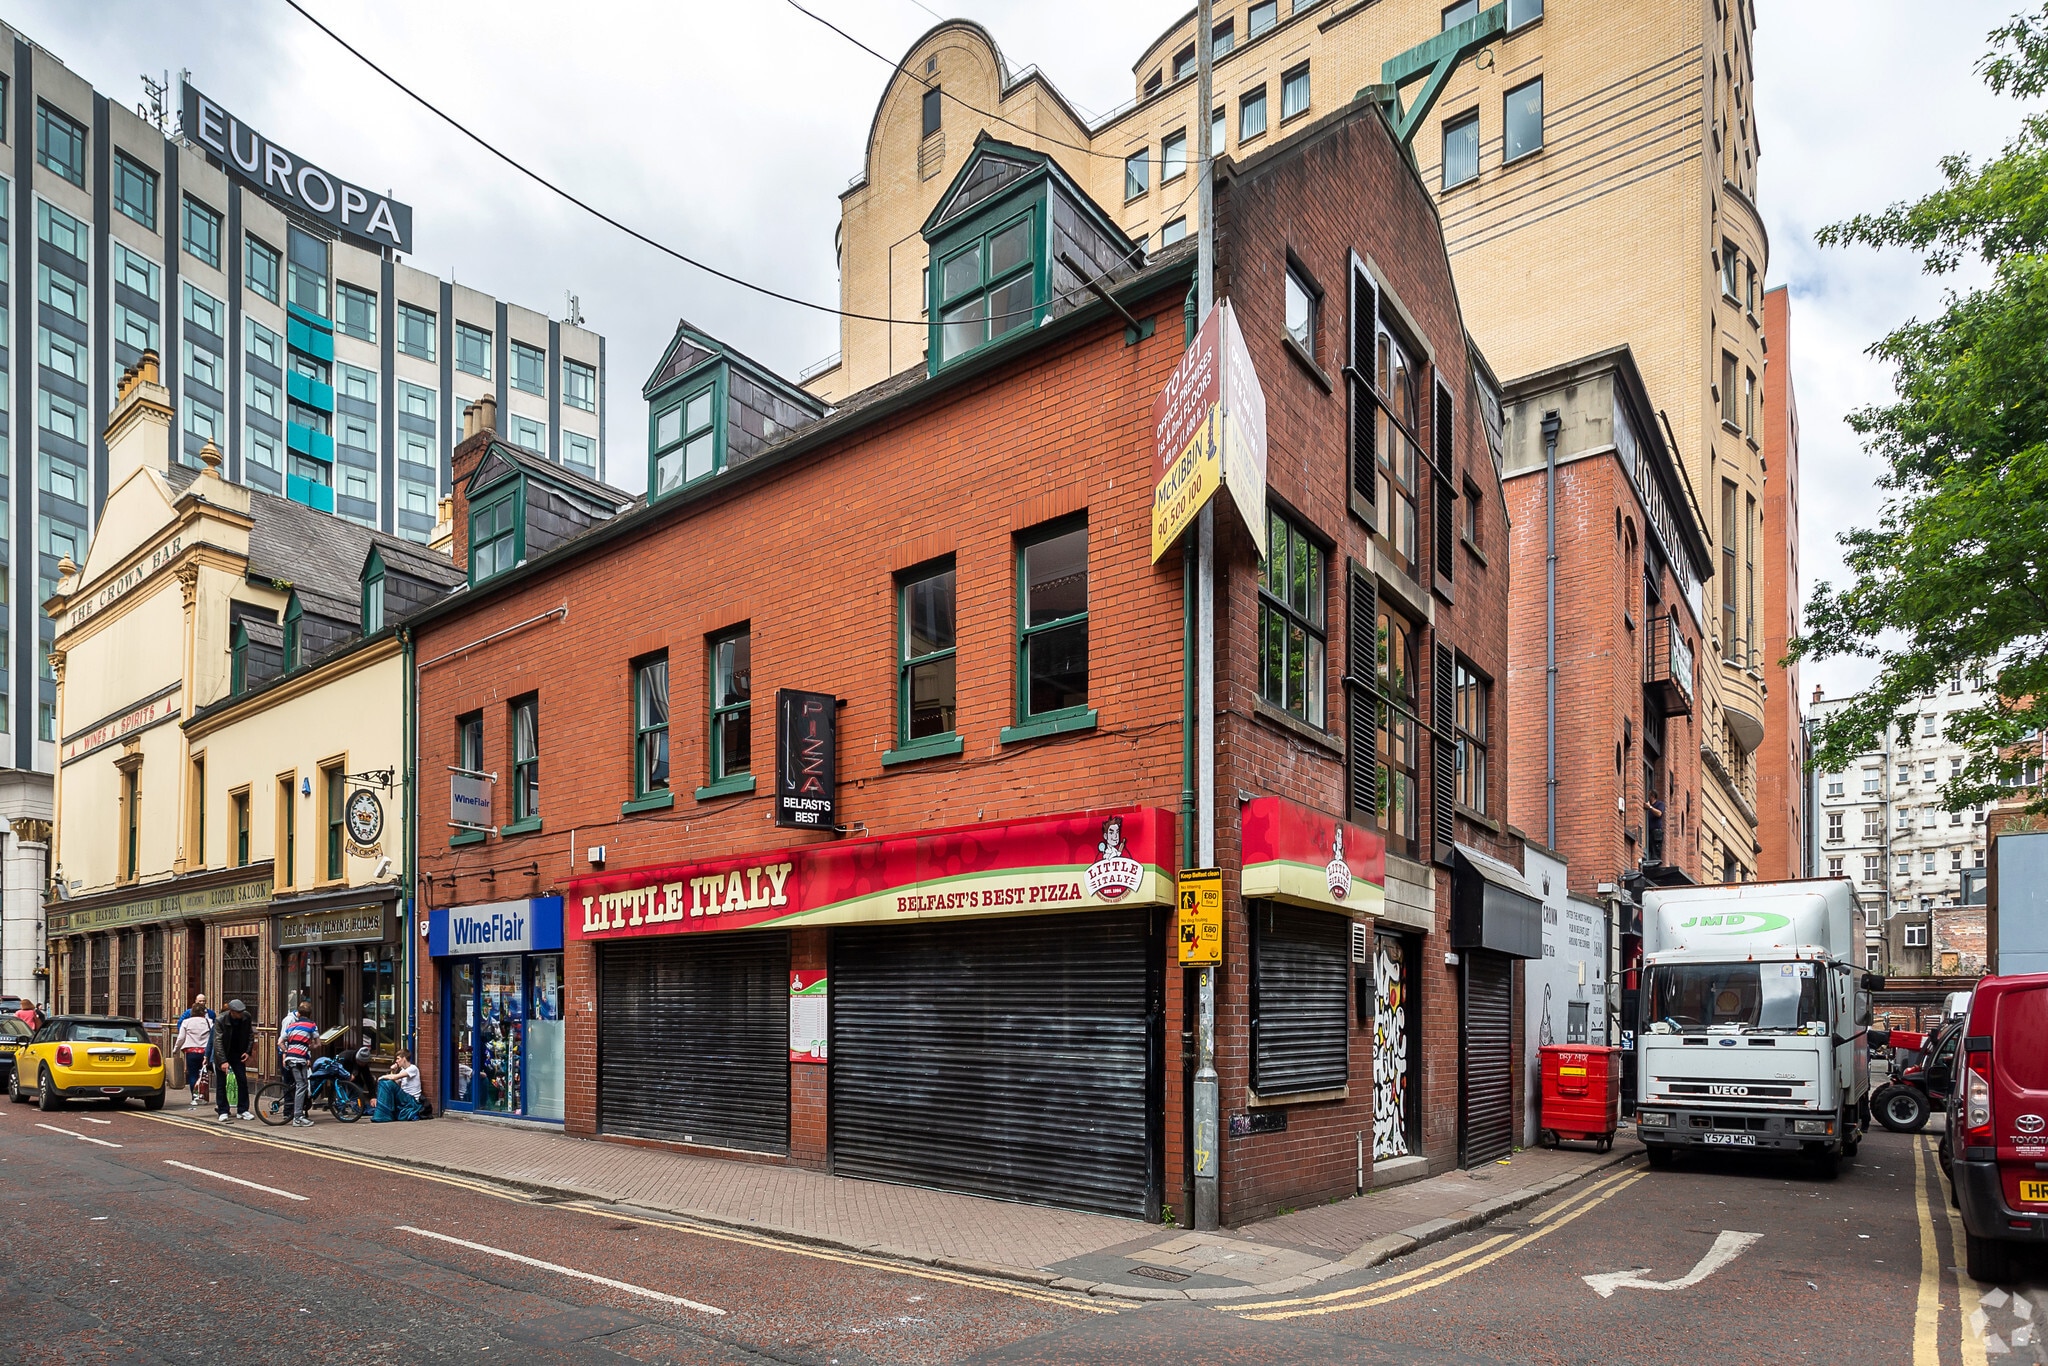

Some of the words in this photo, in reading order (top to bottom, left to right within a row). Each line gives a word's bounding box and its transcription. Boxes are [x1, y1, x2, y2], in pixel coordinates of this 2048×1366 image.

[195, 95, 402, 245] EUROPA
[1164, 370, 1180, 406] TO
[1182, 330, 1204, 382] LET
[1156, 396, 1179, 440] OFFICE
[1179, 345, 1212, 406] PREMISES
[1157, 441, 1167, 458] 1st
[1166, 428, 1172, 442] &
[1171, 409, 1183, 437] 2nd
[1183, 367, 1212, 420] FLOORS
[1163, 448, 1172, 470] 148
[1157, 517, 1168, 540] 90
[1170, 495, 1186, 527] 500
[1188, 473, 1202, 505] 100
[1634, 436, 1691, 596] ROBINSONS
[71, 601, 93, 625] THE
[99, 564, 144, 607] CROWN
[151, 536, 183, 568] BAR
[83, 727, 108, 751] WINES
[111, 725, 116, 738] &
[120, 703, 156, 735] SPIRITS
[800, 700, 826, 795] PIZZA
[454, 793, 490, 808] WineFlair
[783, 796, 831, 812] BELFAST'S
[795, 811, 820, 824] BEST
[1087, 861, 1139, 880] LITTLE
[1097, 874, 1130, 887] ITALY
[1327, 863, 1350, 881] LITTLE
[75, 912, 91, 925] WINES
[95, 907, 120, 922] BRANDIES
[125, 901, 154, 918] WHISKIES
[211, 888, 235, 905] LIQUOR
[238, 882, 267, 900] SALOON
[581, 881, 684, 933] LITTLE
[690, 862, 793, 917] ITALY
[896, 890, 979, 913] BELFAST'S
[981, 887, 1026, 908] BEST
[1028, 882, 1083, 903] PIZZA
[1204, 892, 1217, 900] £80
[284, 924, 298, 938] THE
[299, 921, 322, 936] CROWN
[323, 918, 350, 934] DINING
[351, 915, 380, 931] ROOMS
[1543, 904, 1558, 927] CROWN
[1681, 914, 1746, 928] JMD
[453, 912, 525, 945] WineFlair
[1203, 926, 1217, 934] £80
[1200, 974, 1207, 987] 3
[1559, 1053, 1573, 1064] DRY
[1574, 1053, 1588, 1062] MIX
[1774, 1072, 1797, 1080] Cargo
[1708, 1085, 1750, 1096] IVECO
[1704, 1133, 1732, 1145] Y573
[1733, 1135, 1755, 1146] MEN
[2028, 1183, 2048, 1198] HR
